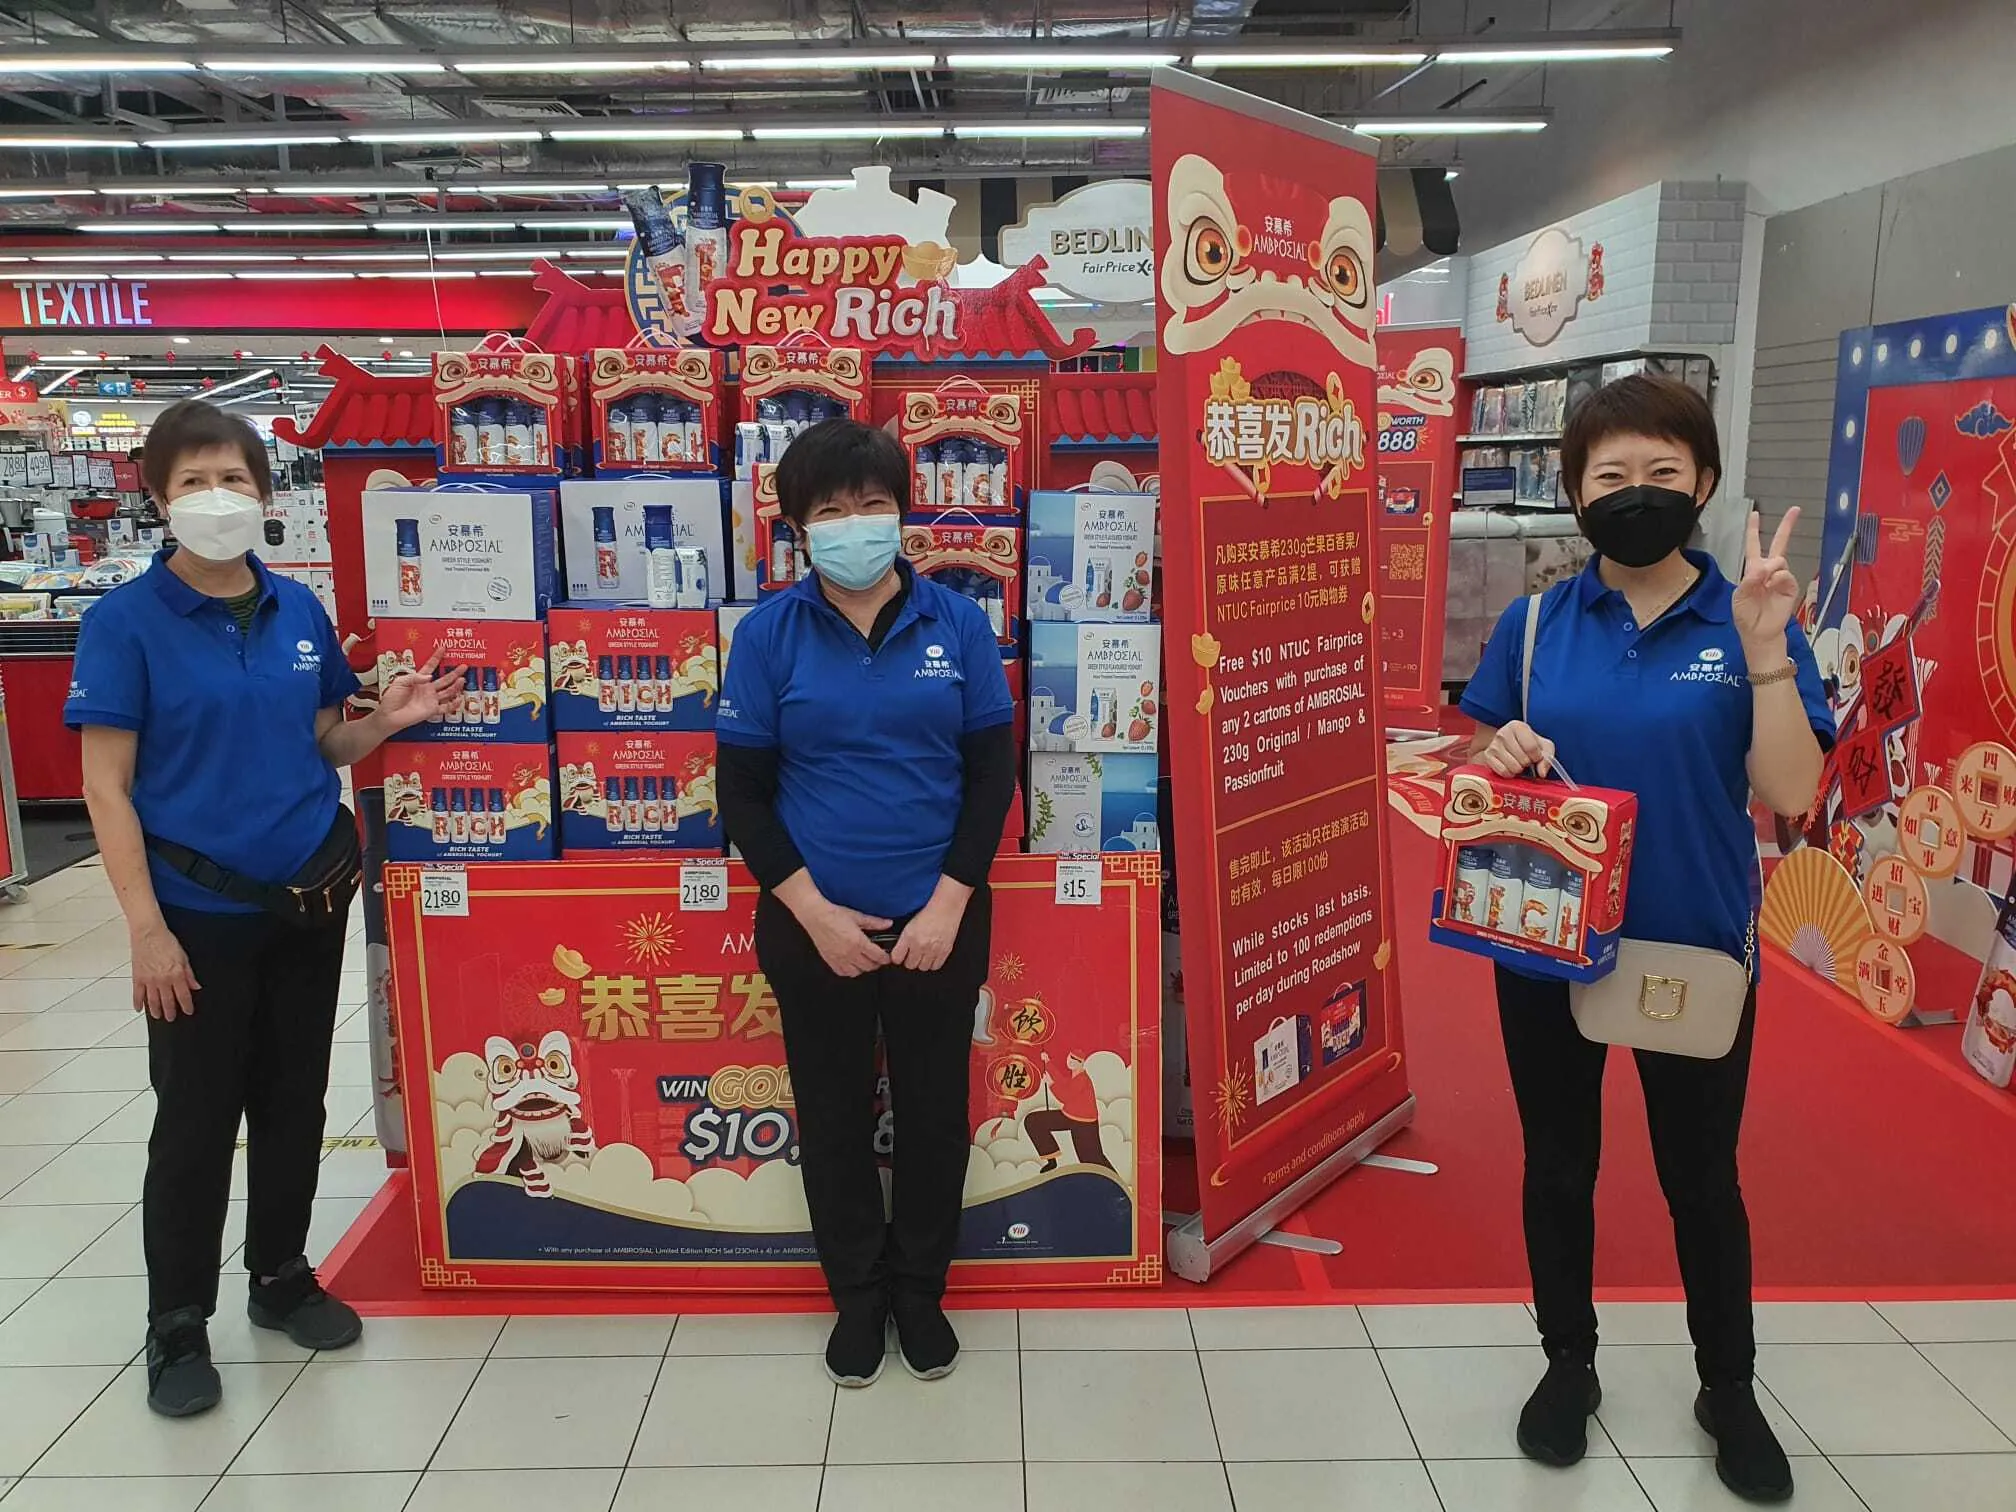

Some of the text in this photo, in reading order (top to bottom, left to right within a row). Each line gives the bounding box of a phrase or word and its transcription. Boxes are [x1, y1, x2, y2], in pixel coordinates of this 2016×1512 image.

[1050, 226, 1154, 256] BEDLIN
[1264, 215, 1293, 237] 安慕希
[735, 226, 902, 286] Happy
[13, 281, 153, 326] TEXTILE
[712, 285, 960, 344] New Rich
[1391, 416, 1424, 425] WORTH
[447, 524, 485, 538] 安慕希
[1217, 601, 1248, 624] NTUC
[1250, 597, 1296, 619] Fairprice
[1219, 653, 1244, 674] Free
[1252, 646, 1272, 669] $10
[1280, 638, 1310, 660] NTUC
[1317, 630, 1364, 654] Fairprice
[1220, 679, 1268, 704] Vouchers
[1276, 671, 1297, 690] with
[1304, 660, 1348, 686] purchase
[1354, 654, 1365, 672] of
[1222, 681, 1365, 736] any 2 cartons of AMBROSIAL
[1223, 708, 1366, 765] 230g Original / Mango &
[1224, 759, 1285, 794] Passionfruit
[1503, 792, 1548, 816] 安慕希
[696, 857, 726, 866] Special
[1072, 851, 1100, 862] Special
[423, 889, 461, 909] 21.80
[683, 884, 720, 904] 21.80
[1063, 879, 1087, 898] $15
[1232, 882, 1373, 958] While stocks last basis.
[720, 932, 755, 955] AM
[1234, 906, 1373, 988] Limited to 100 redemptions
[1236, 939, 1362, 1021] per day during Roadshow
[660, 1067, 797, 1108] WIN GOL
[1291, 1149, 1307, 1168] and
[1307, 1123, 1346, 1159] conditions
[1346, 1109, 1366, 1133] apply
